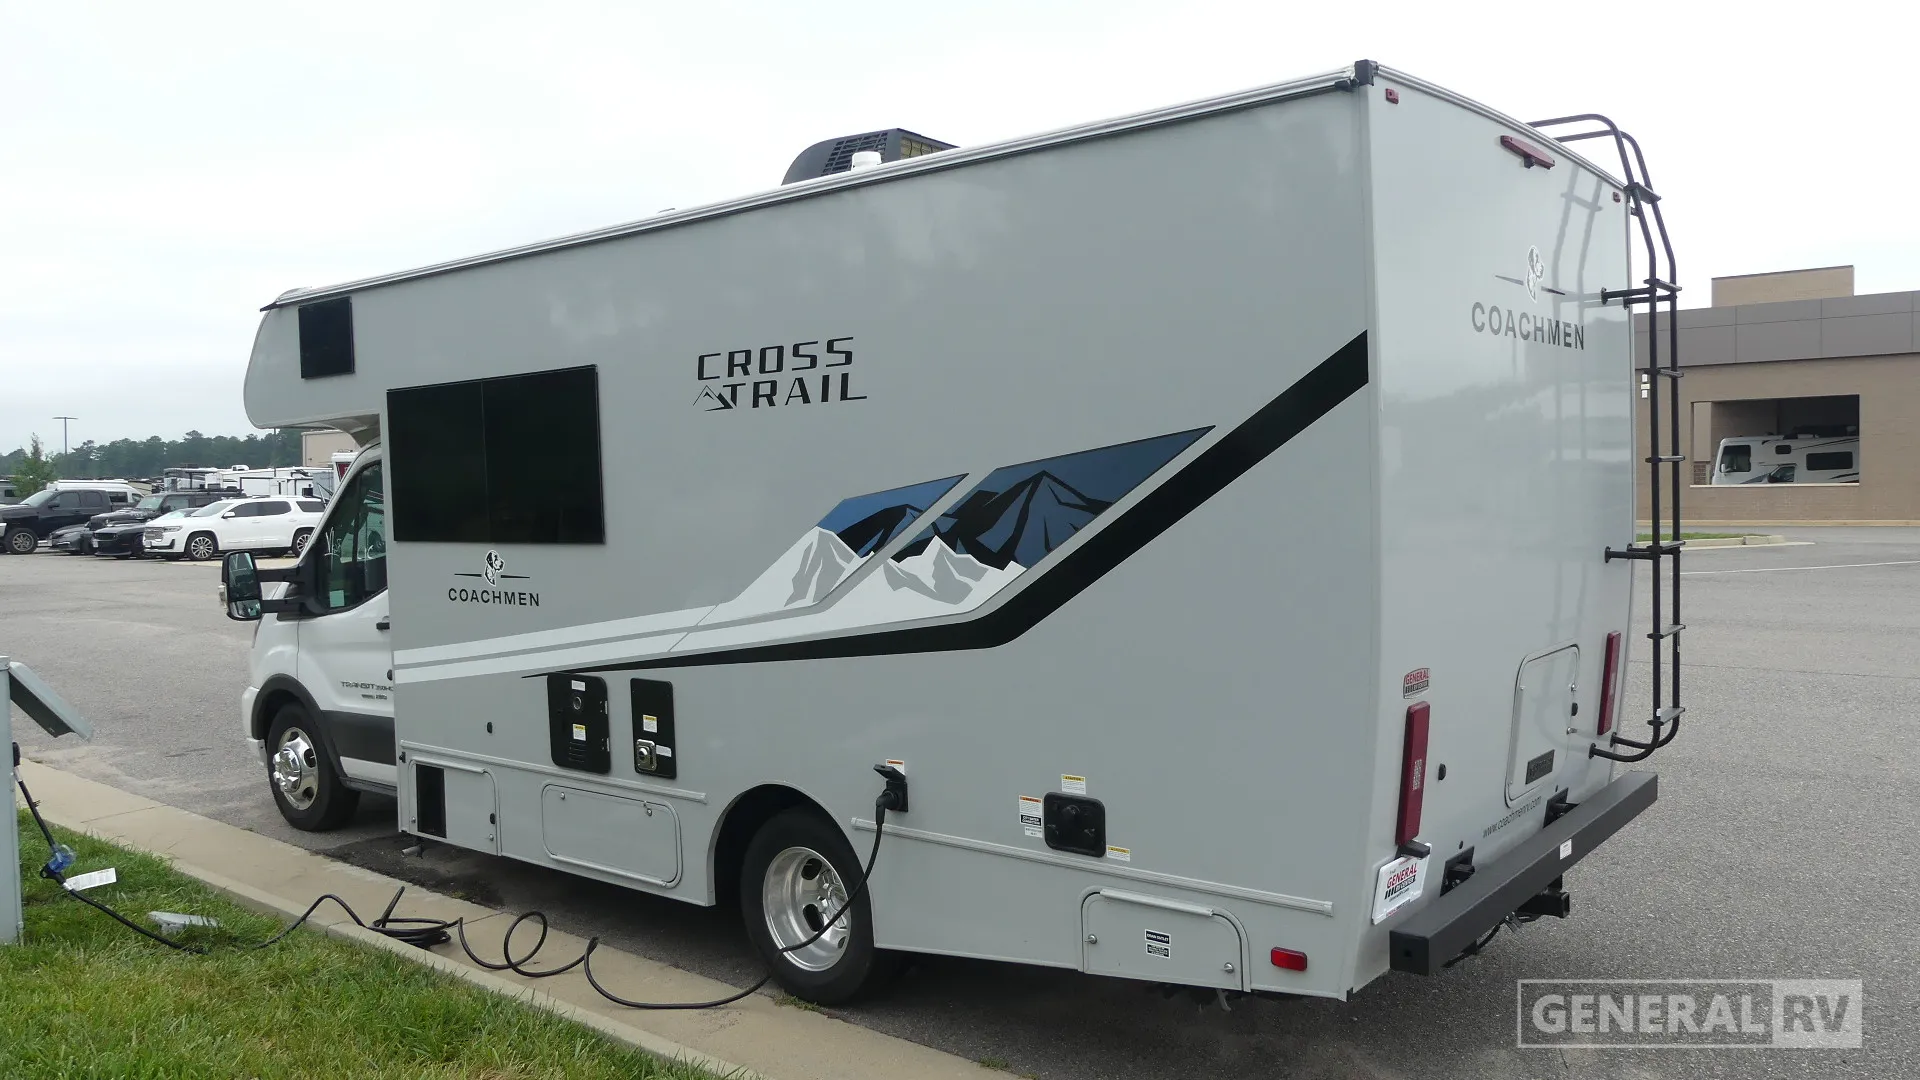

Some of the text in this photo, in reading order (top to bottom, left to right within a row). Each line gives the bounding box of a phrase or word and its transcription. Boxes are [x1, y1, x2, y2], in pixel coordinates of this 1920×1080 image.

[1471, 301, 1584, 350] COACHMEN
[697, 336, 854, 380] CROSS
[722, 372, 868, 408] TRAIL
[448, 587, 540, 607] COACHMEN
[341, 681, 375, 690] TRANSIT
[1405, 669, 1430, 685] GENERAL
[1386, 862, 1417, 889] GENERAL
